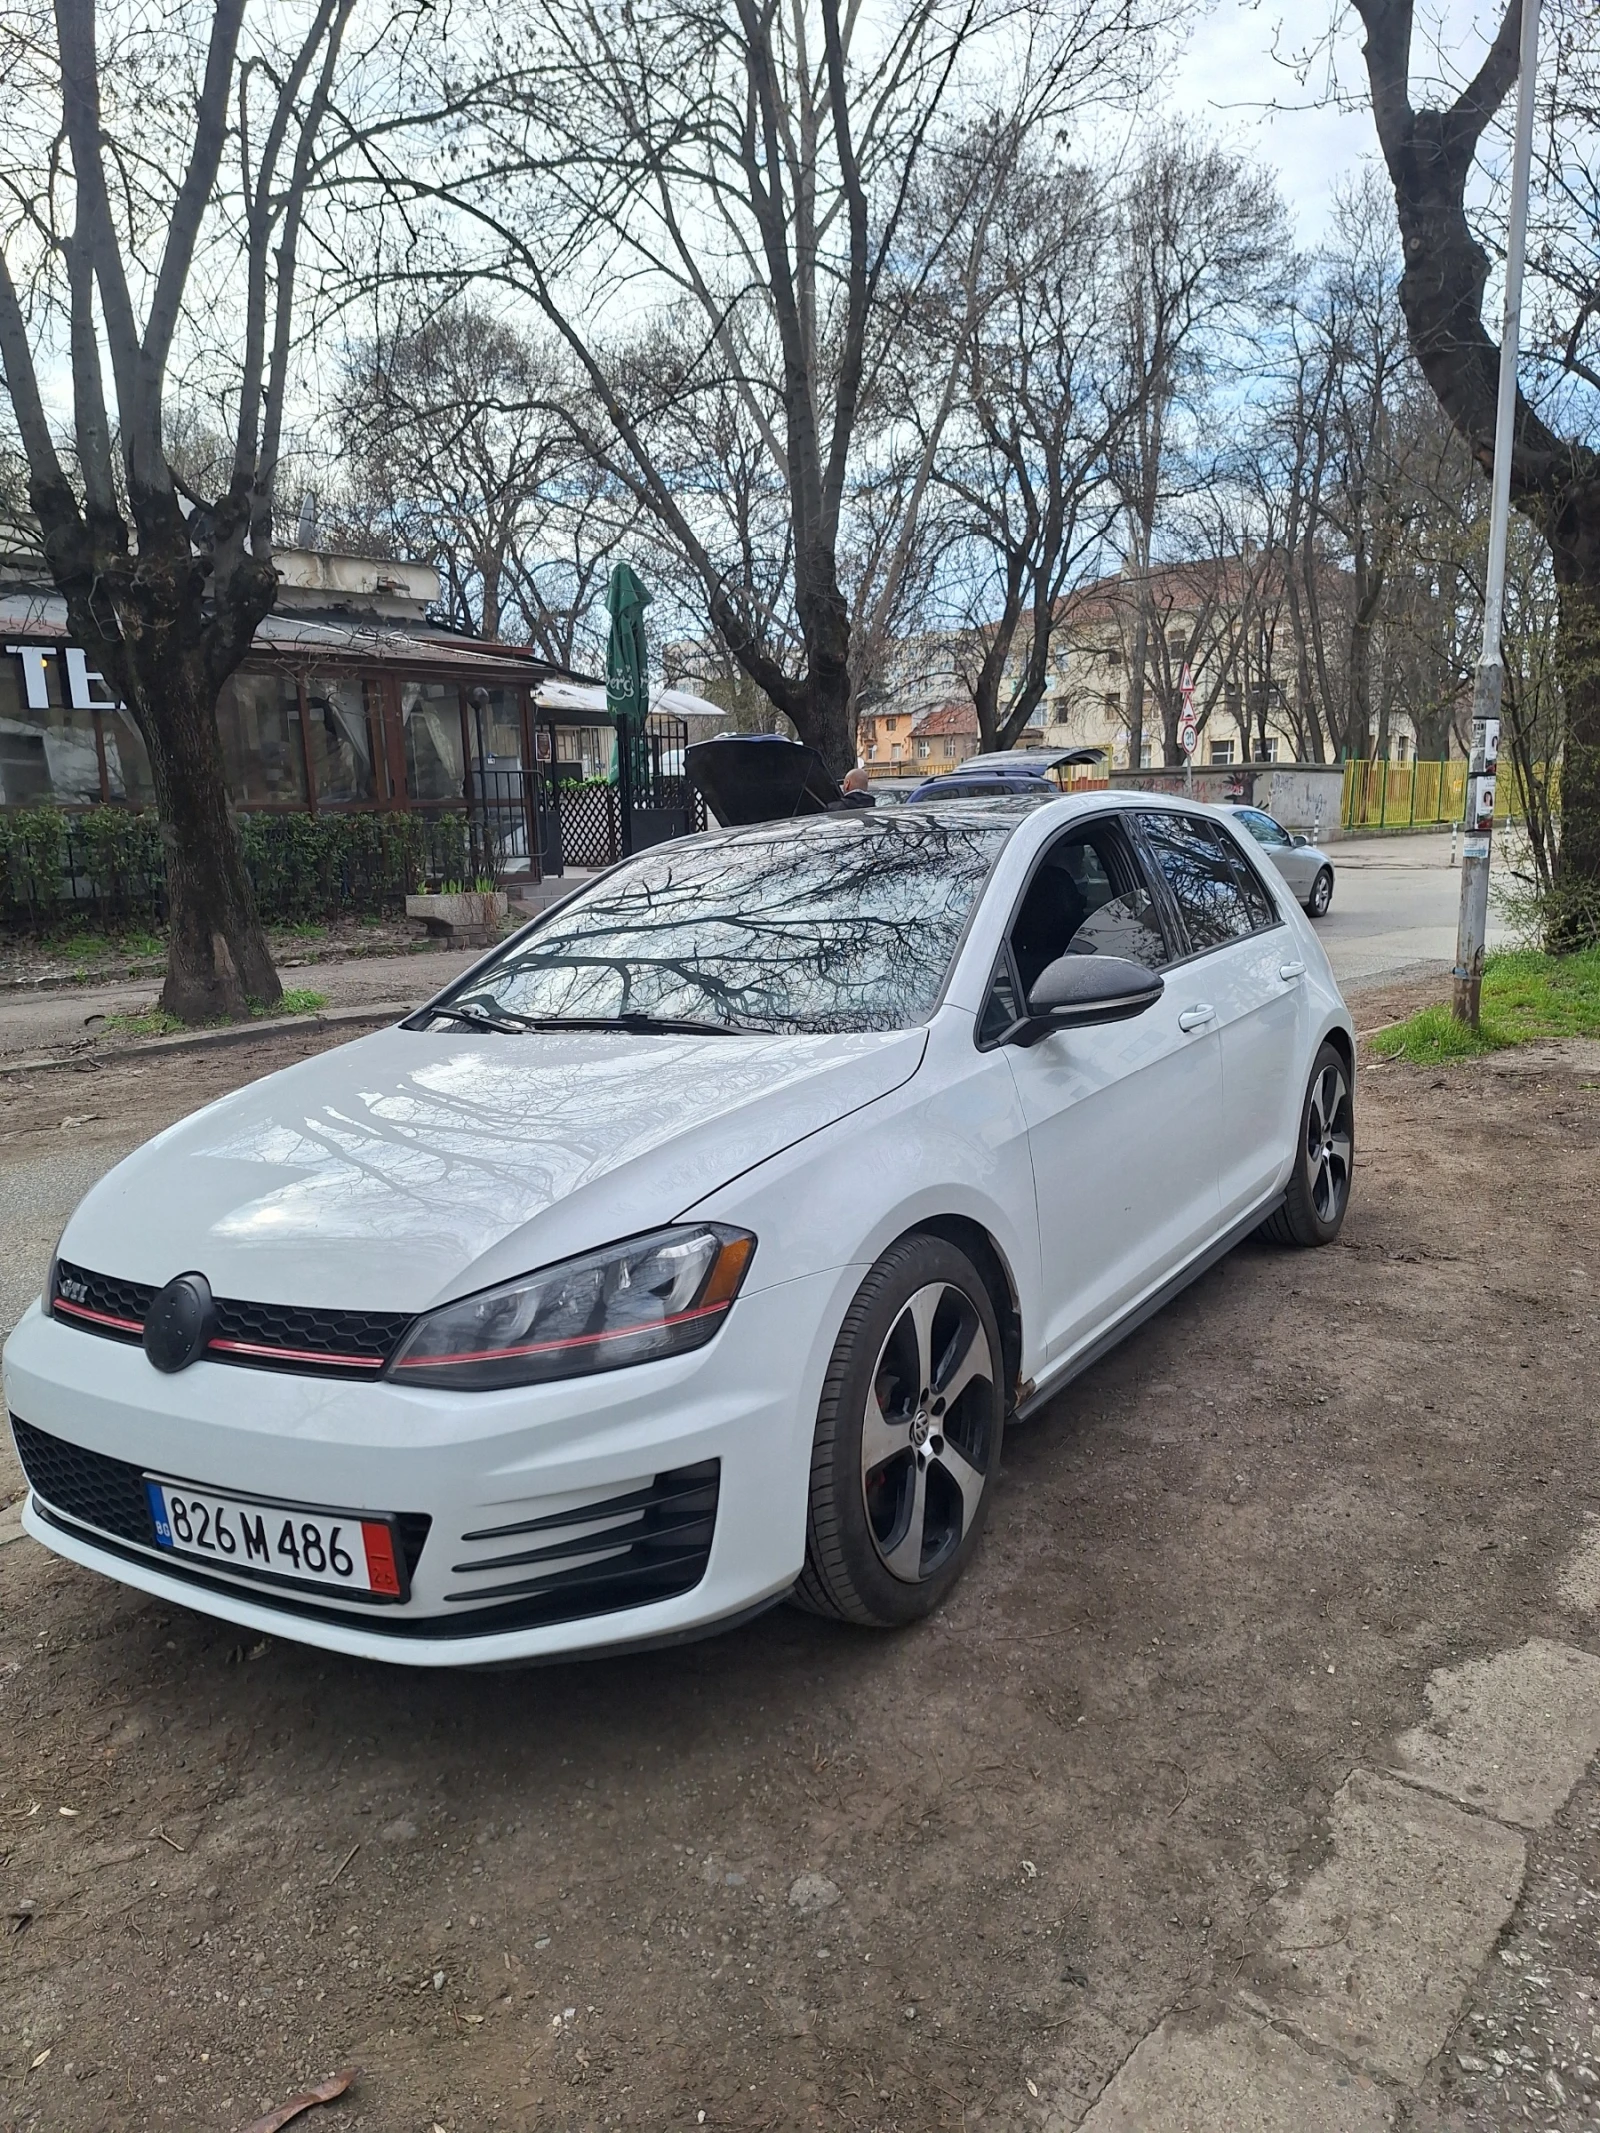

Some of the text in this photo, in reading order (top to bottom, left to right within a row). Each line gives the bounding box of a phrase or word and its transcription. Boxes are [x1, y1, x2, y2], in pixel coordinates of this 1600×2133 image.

[5, 645, 127, 710] TE
[1185, 731, 1194, 747] 30
[155, 1521, 170, 1537] BG
[170, 1497, 353, 1577] 826 M 486
